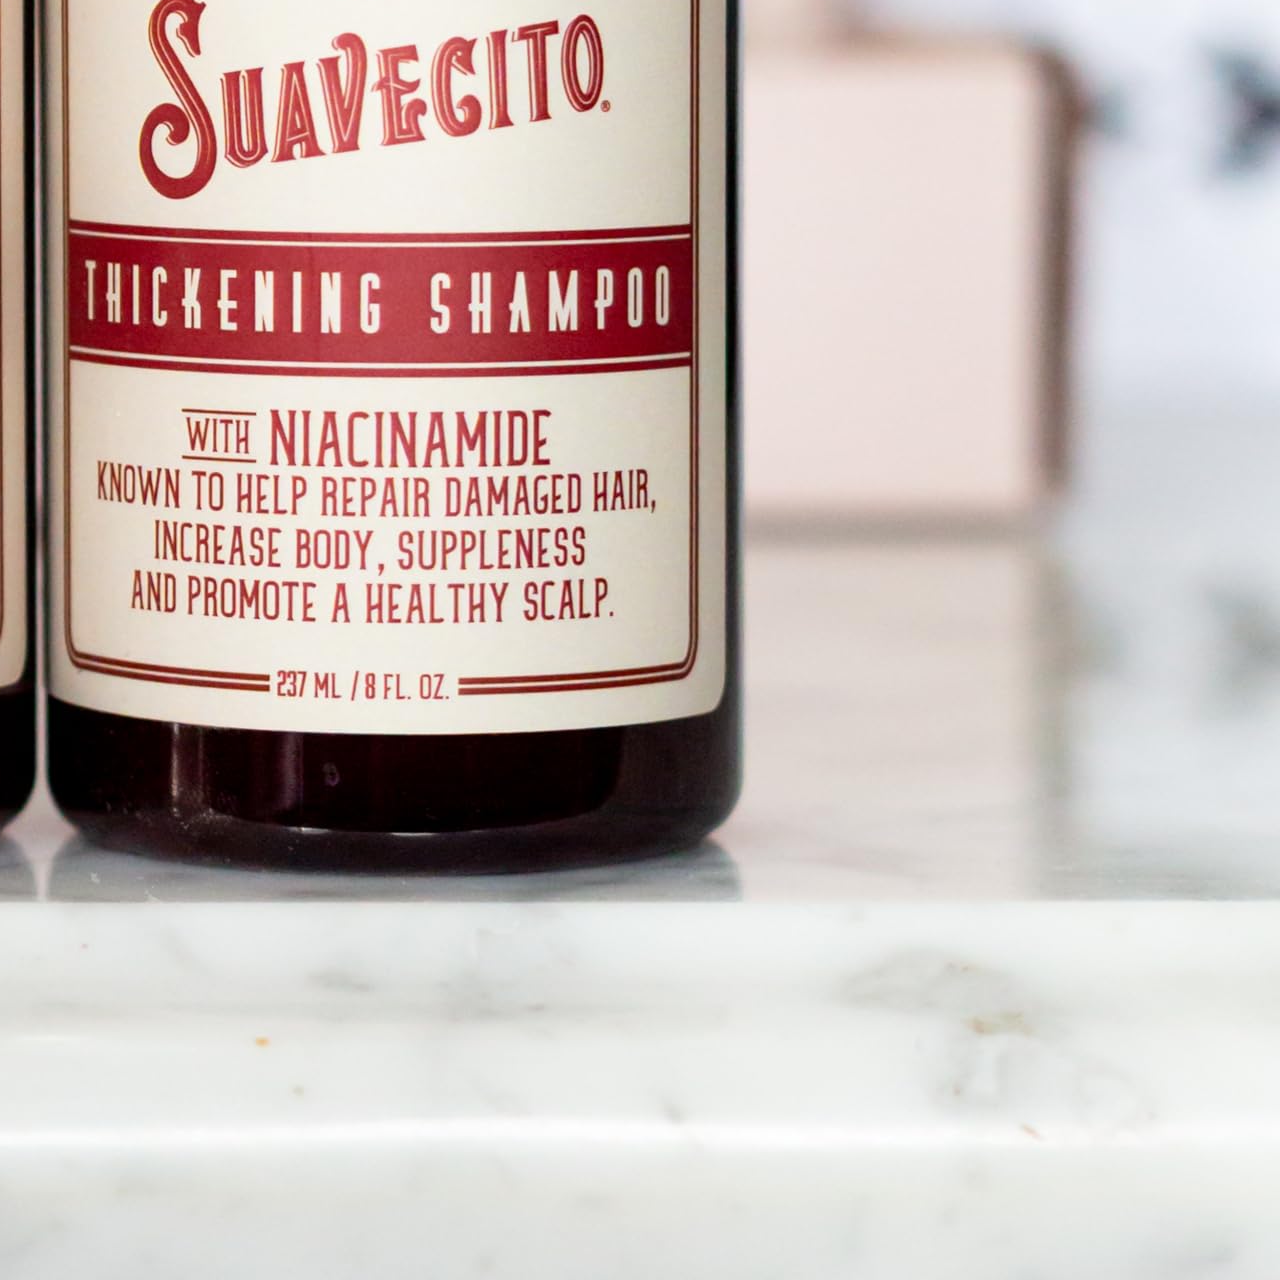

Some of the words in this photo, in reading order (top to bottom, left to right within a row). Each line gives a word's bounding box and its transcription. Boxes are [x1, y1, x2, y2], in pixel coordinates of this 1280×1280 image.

[85, 260, 381, 335] THICKENING
[429, 265, 670, 335] SHAMPOO
[185, 416, 250, 455] WITH
[269, 408, 552, 469] NIACINAMIDE
[96, 460, 182, 509] KNOWN
[191, 470, 226, 513] TO
[236, 472, 309, 516] HELP
[320, 476, 431, 518] REPAIR
[444, 473, 583, 518] DAMAGED
[592, 469, 658, 514] HAIR,
[153, 520, 282, 569] INCREASE
[397, 526, 587, 572] SUPPLENESS
[130, 571, 178, 614] AND
[186, 576, 318, 624] PROMOTE
[330, 582, 351, 624] A
[365, 582, 509, 625] HEALTHY
[522, 576, 615, 622] SCALP.
[276, 670, 308, 698] 237
[313, 671, 342, 700] ML
[364, 672, 376, 701] 8
[382, 672, 411, 701] FL.
[418, 672, 451, 701] OZ.
